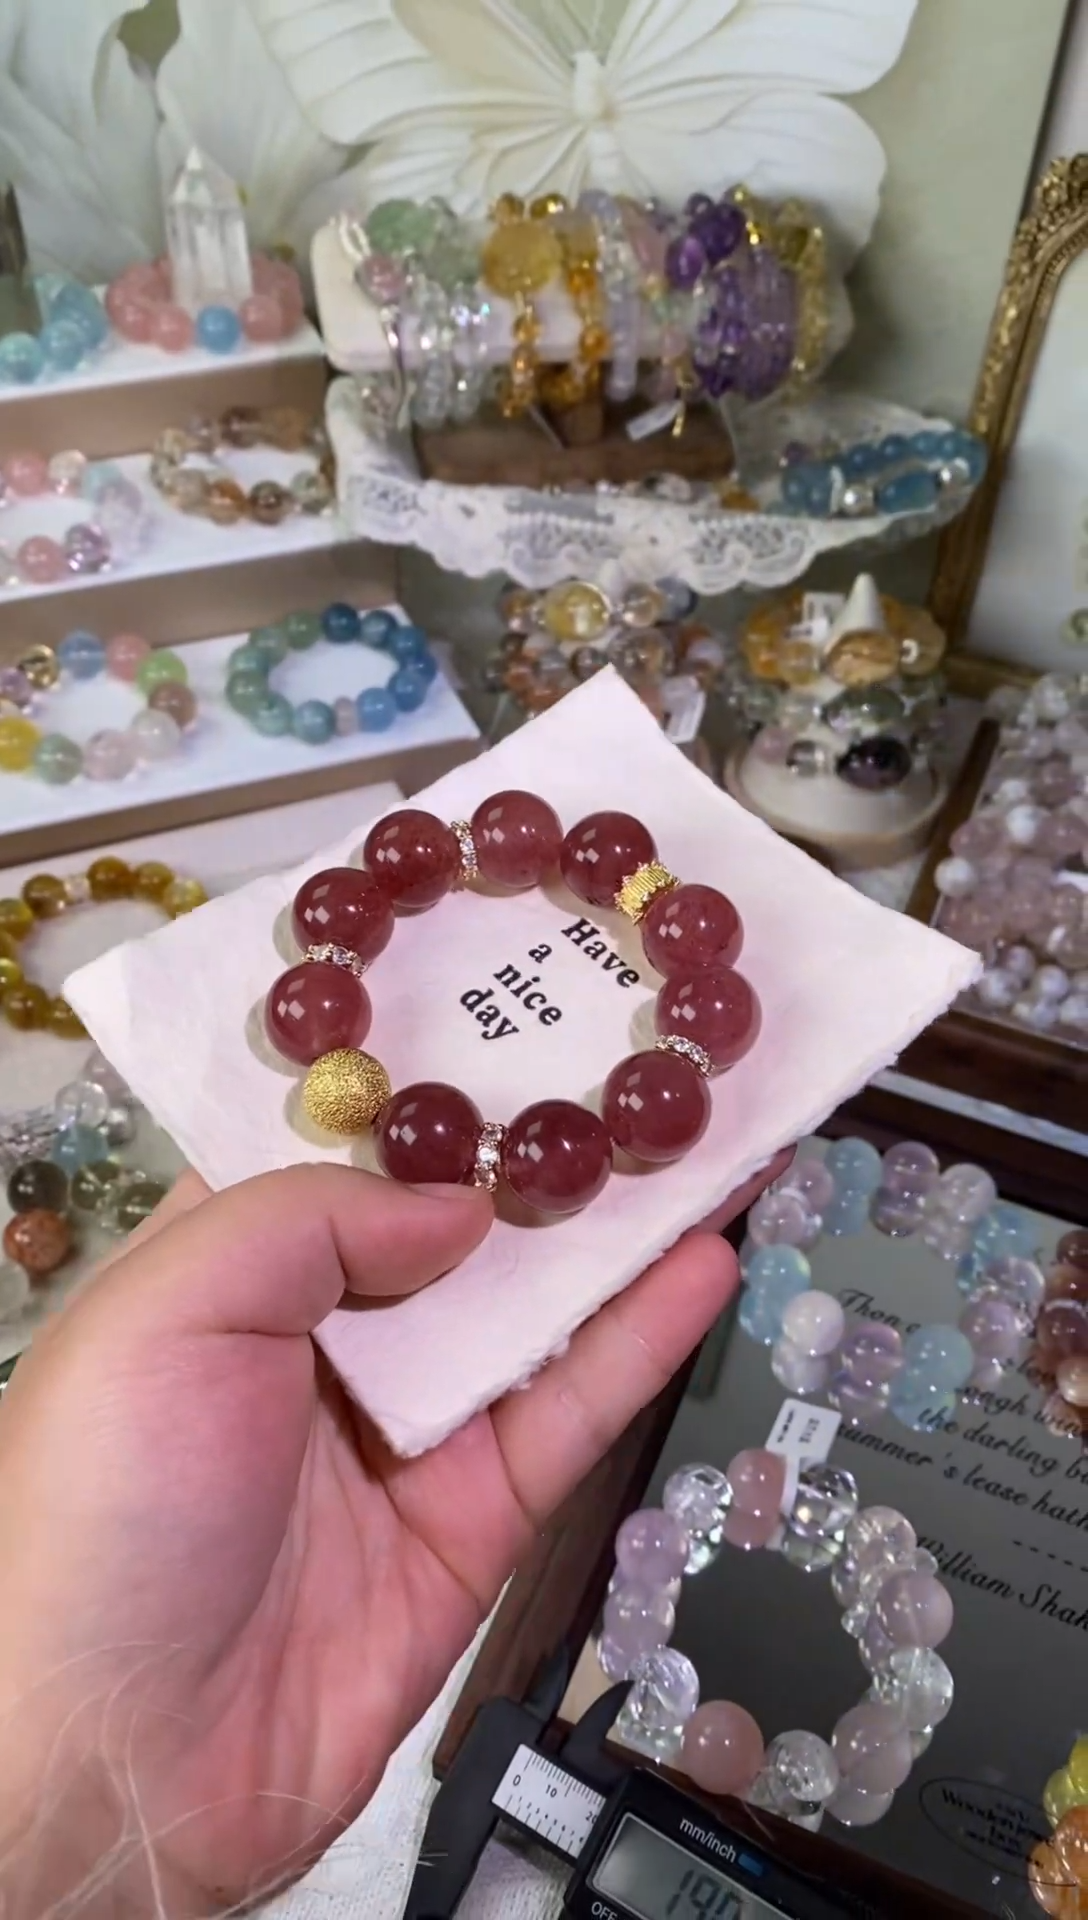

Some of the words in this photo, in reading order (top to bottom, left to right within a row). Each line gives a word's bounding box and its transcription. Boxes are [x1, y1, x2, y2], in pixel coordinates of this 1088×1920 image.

[528, 943, 552, 963] a
[561, 918, 640, 988] Have
[460, 987, 519, 1041] day
[493, 964, 562, 1026] nice
[962, 1422, 1058, 1478] darling
[963, 1463, 1029, 1506] lease
[512, 1774, 522, 1787] 0
[545, 1784, 558, 1798] 10
[679, 1817, 736, 1863] mm/inch
